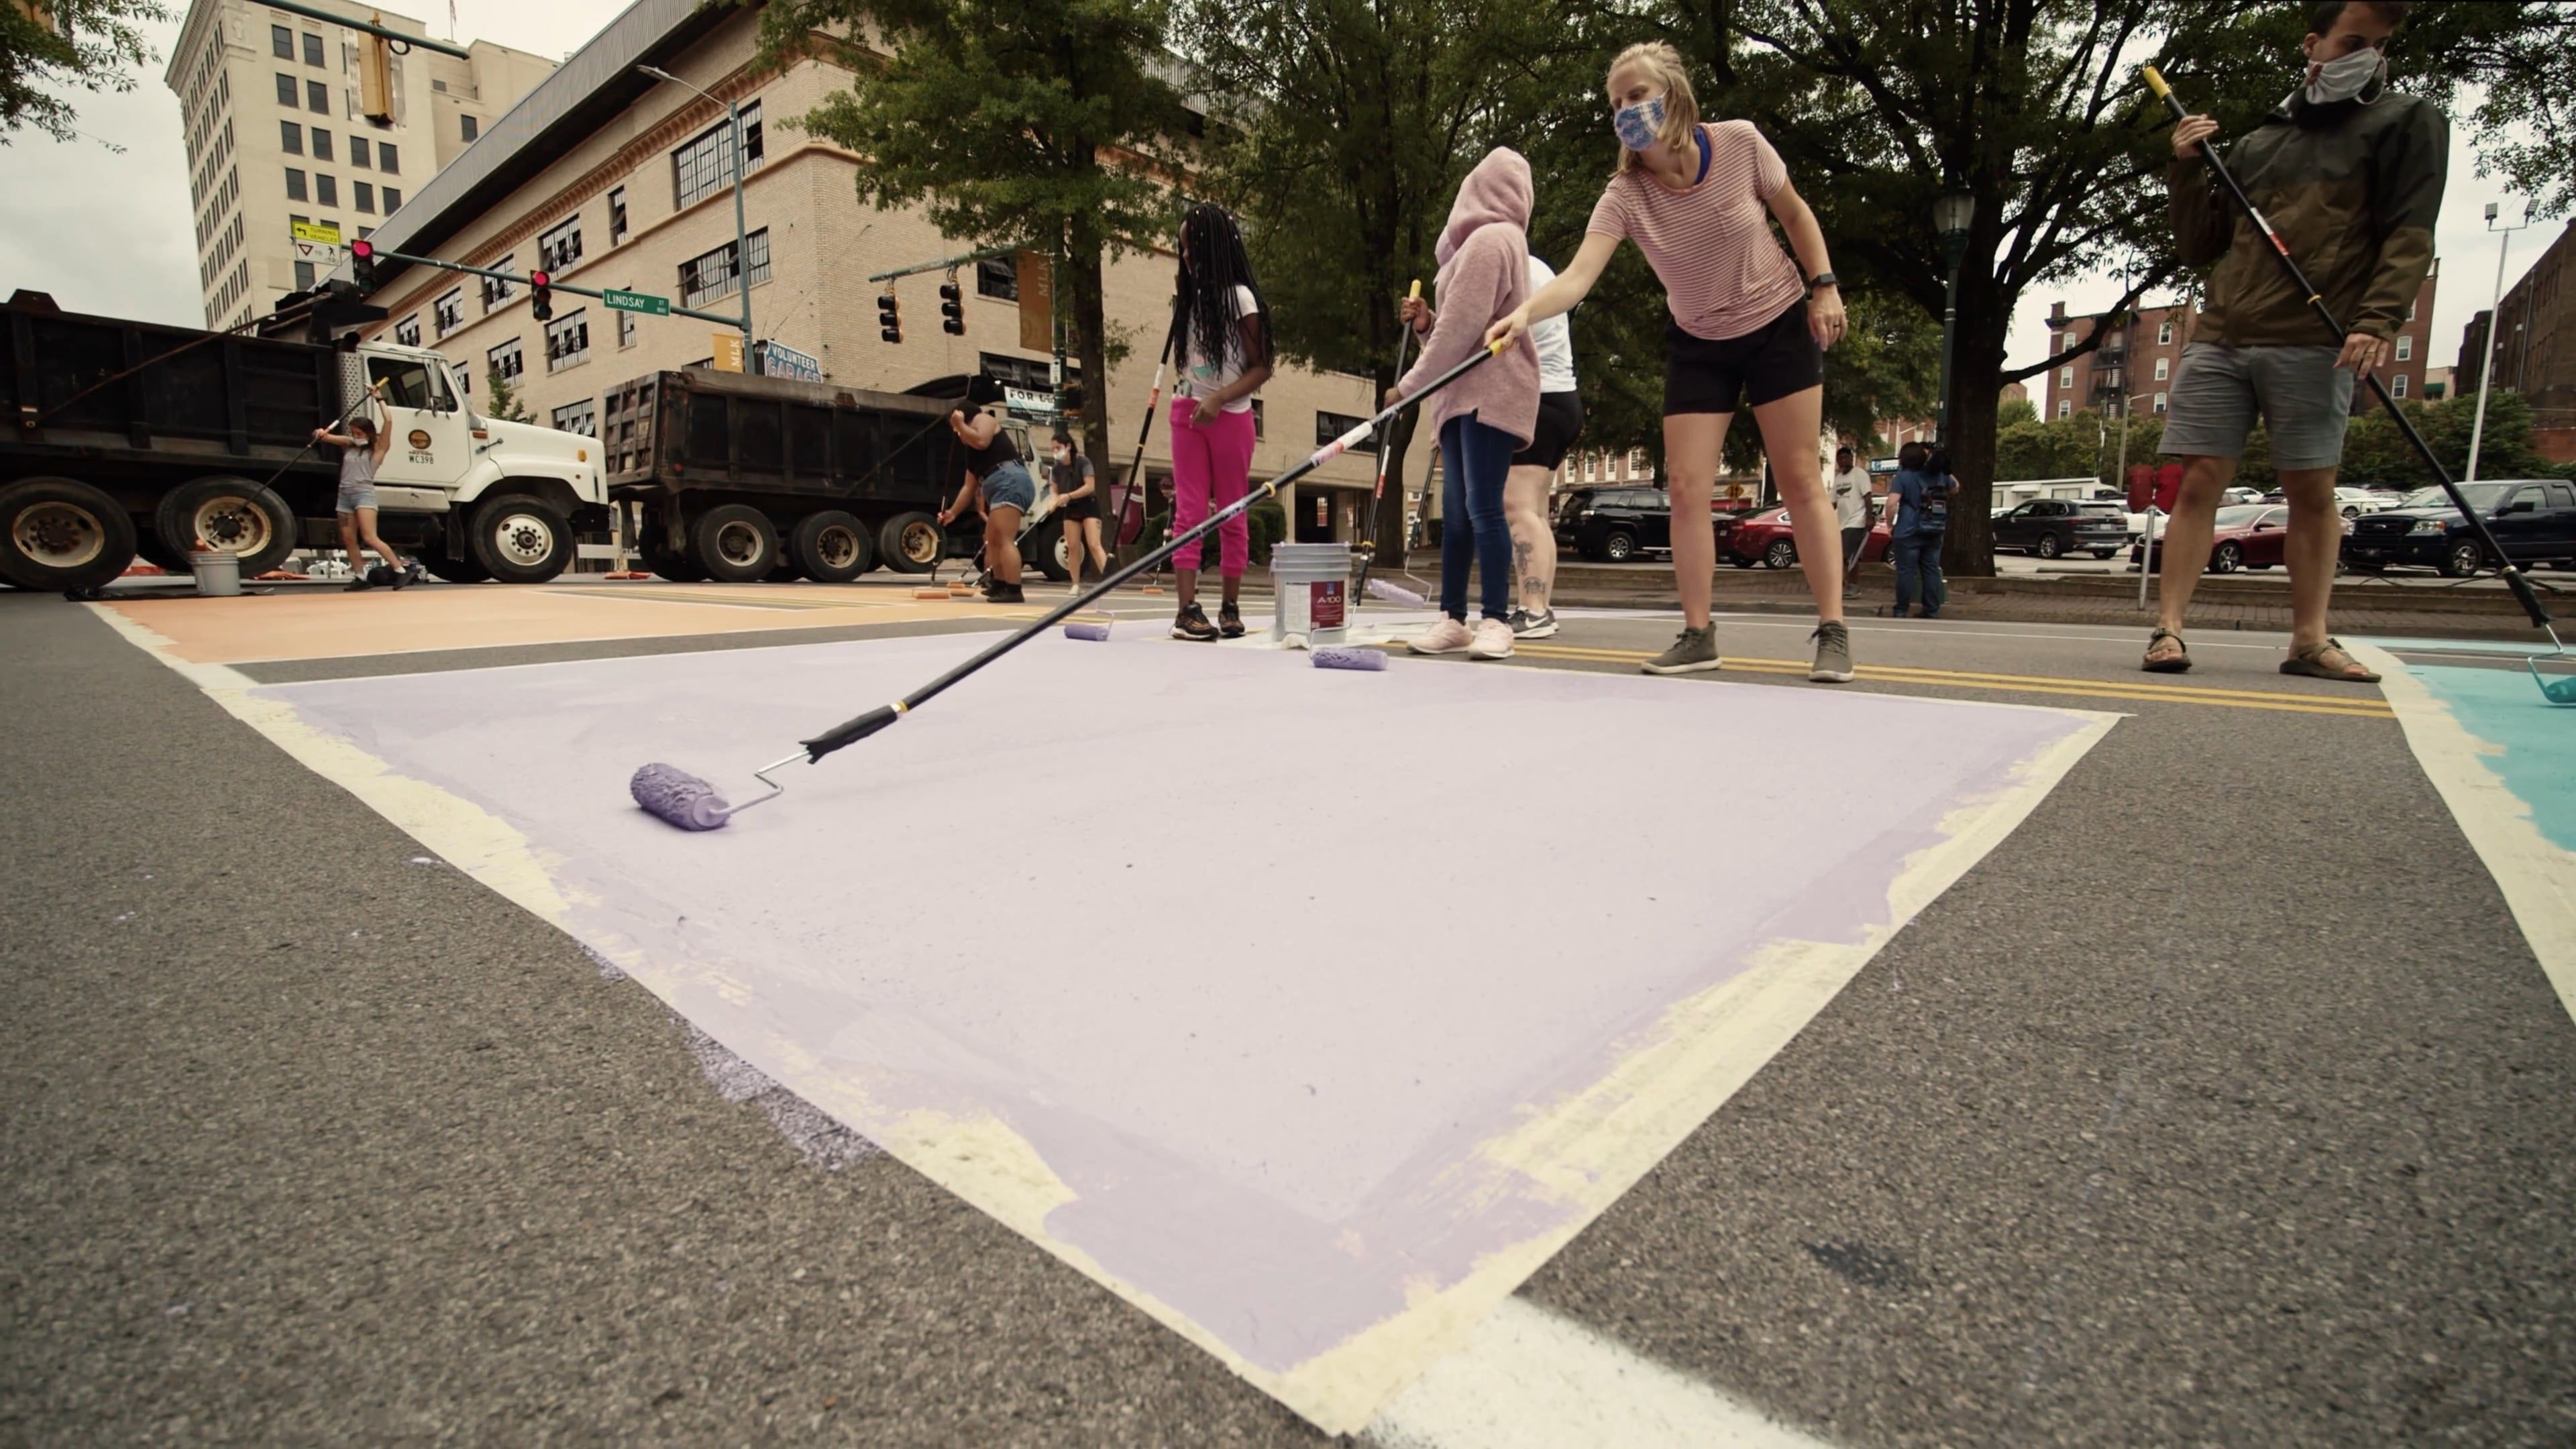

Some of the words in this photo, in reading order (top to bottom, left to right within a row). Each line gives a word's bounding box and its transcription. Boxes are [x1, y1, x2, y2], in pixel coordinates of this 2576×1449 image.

[309, 227, 337, 236] TURNING
[310, 235, 337, 243] VEHICLES
[1037, 260, 1049, 297] MLK
[606, 293, 645, 309] LINDSAY
[730, 339, 741, 367] MLK
[771, 344, 816, 369] VOLUNTEER
[767, 356, 822, 383] GARAGE
[1010, 389, 1034, 401] FOR
[409, 455, 434, 464] WC398
